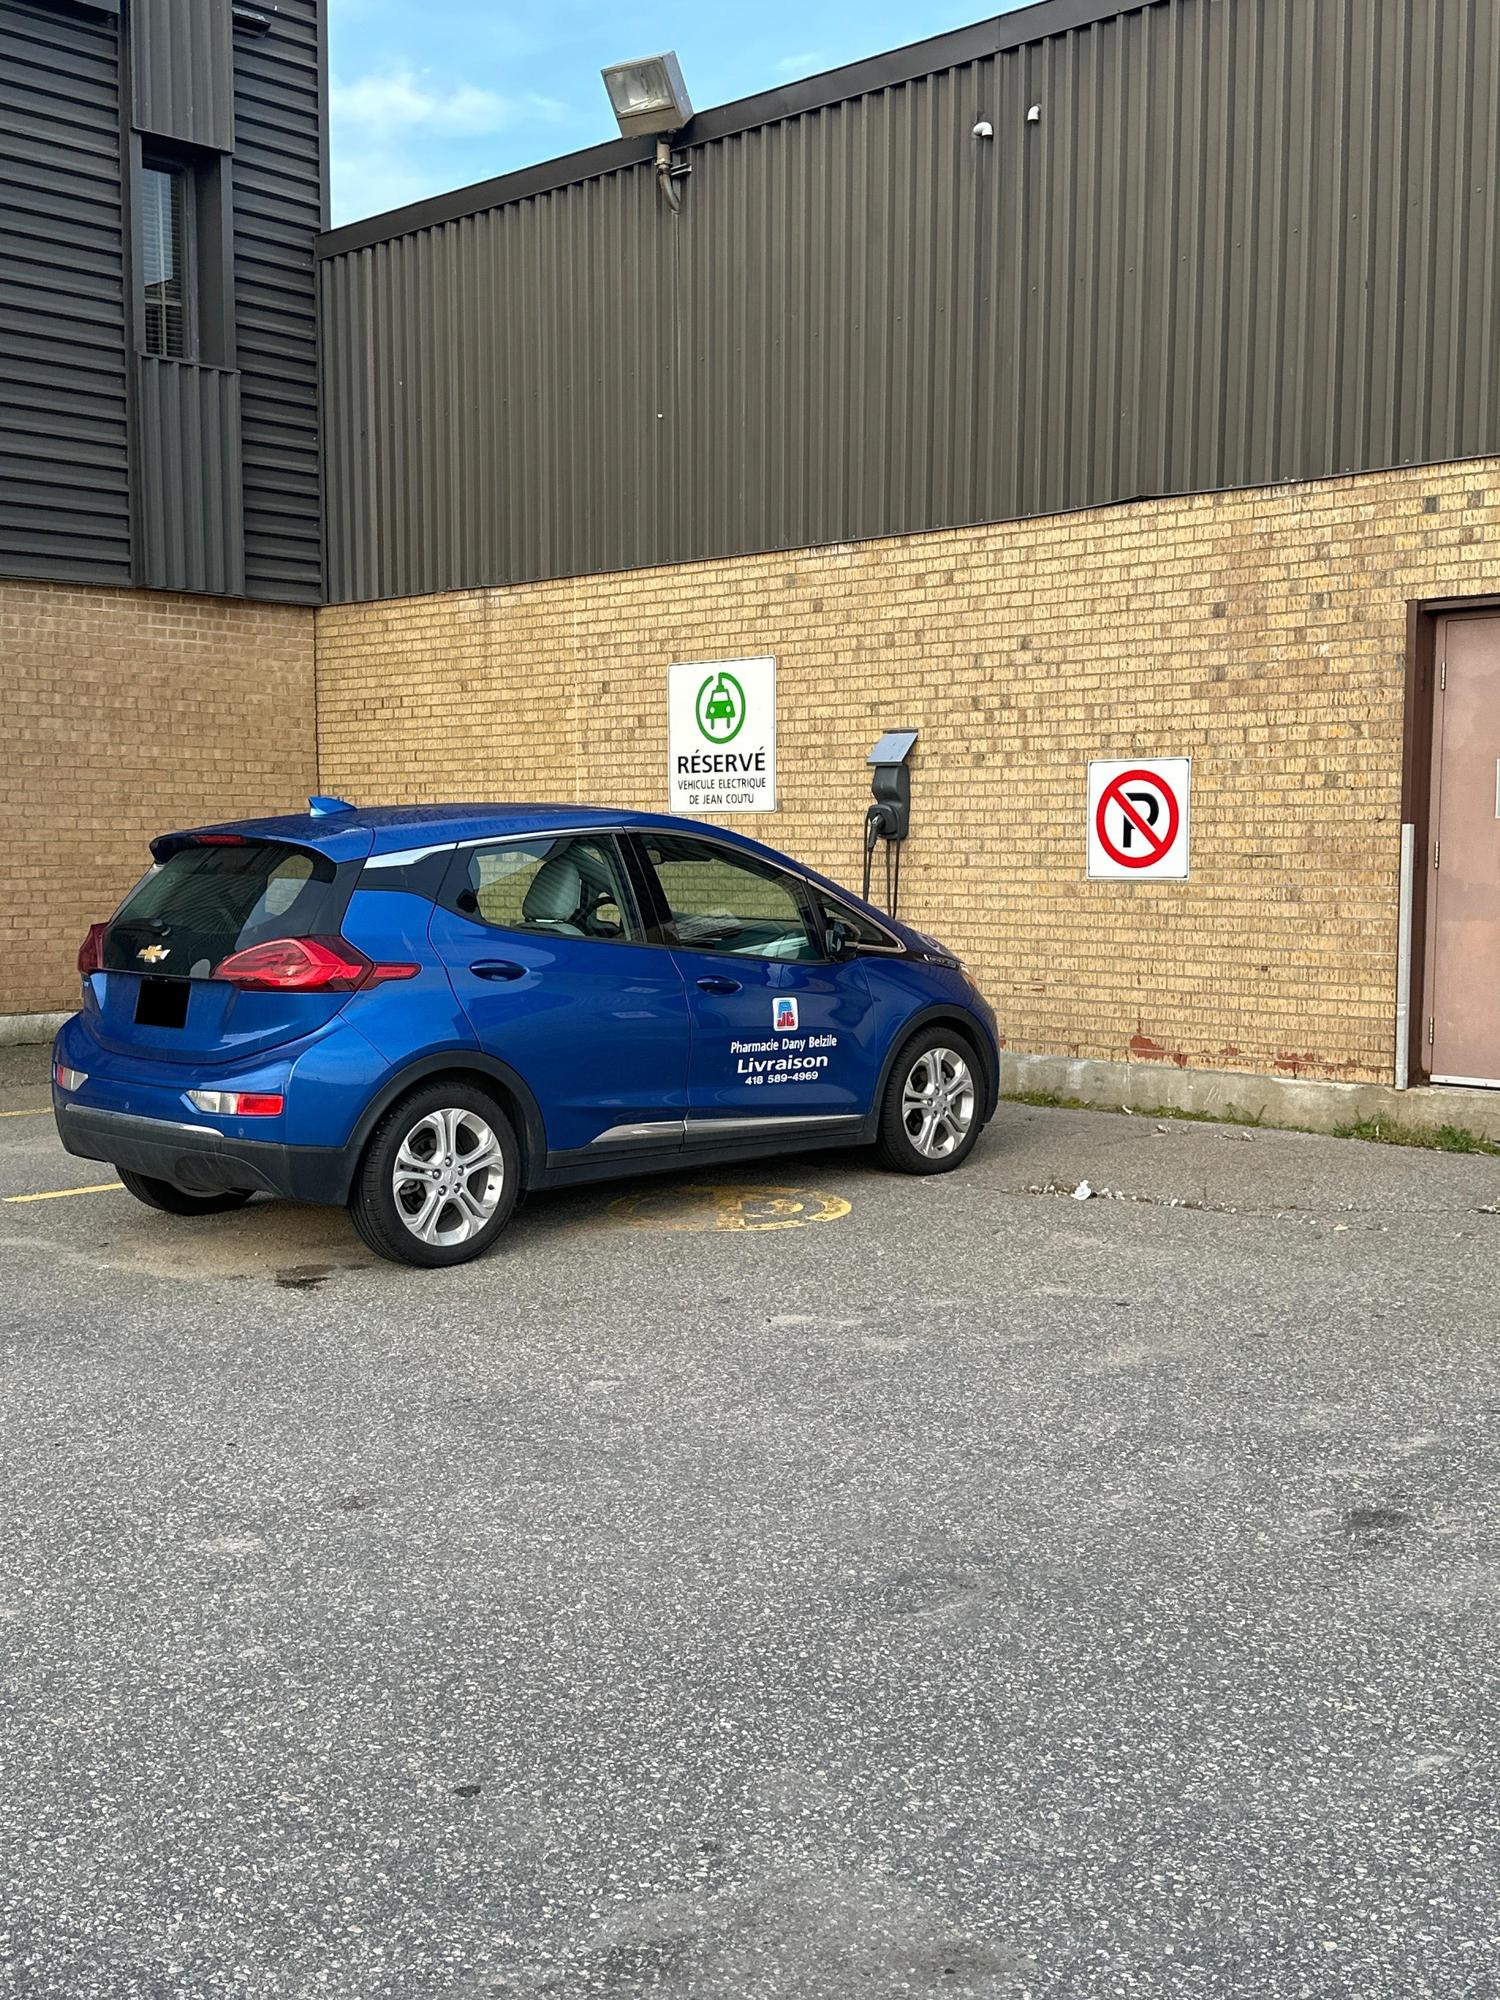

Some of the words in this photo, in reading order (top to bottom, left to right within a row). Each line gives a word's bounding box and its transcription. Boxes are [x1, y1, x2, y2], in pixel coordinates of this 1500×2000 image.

[677, 746, 766, 774] RÉSERVÉ
[689, 794, 699, 805] DE
[702, 794, 723, 805] JEAN
[725, 793, 755, 804] COUTU
[730, 1038, 779, 1054] Pharmacie
[781, 1038, 806, 1052] Dany
[808, 1034, 838, 1048] Belzile
[737, 1054, 829, 1074] Livraison
[744, 1075, 764, 1086] 418
[767, 1070, 819, 1084] 589-4969
